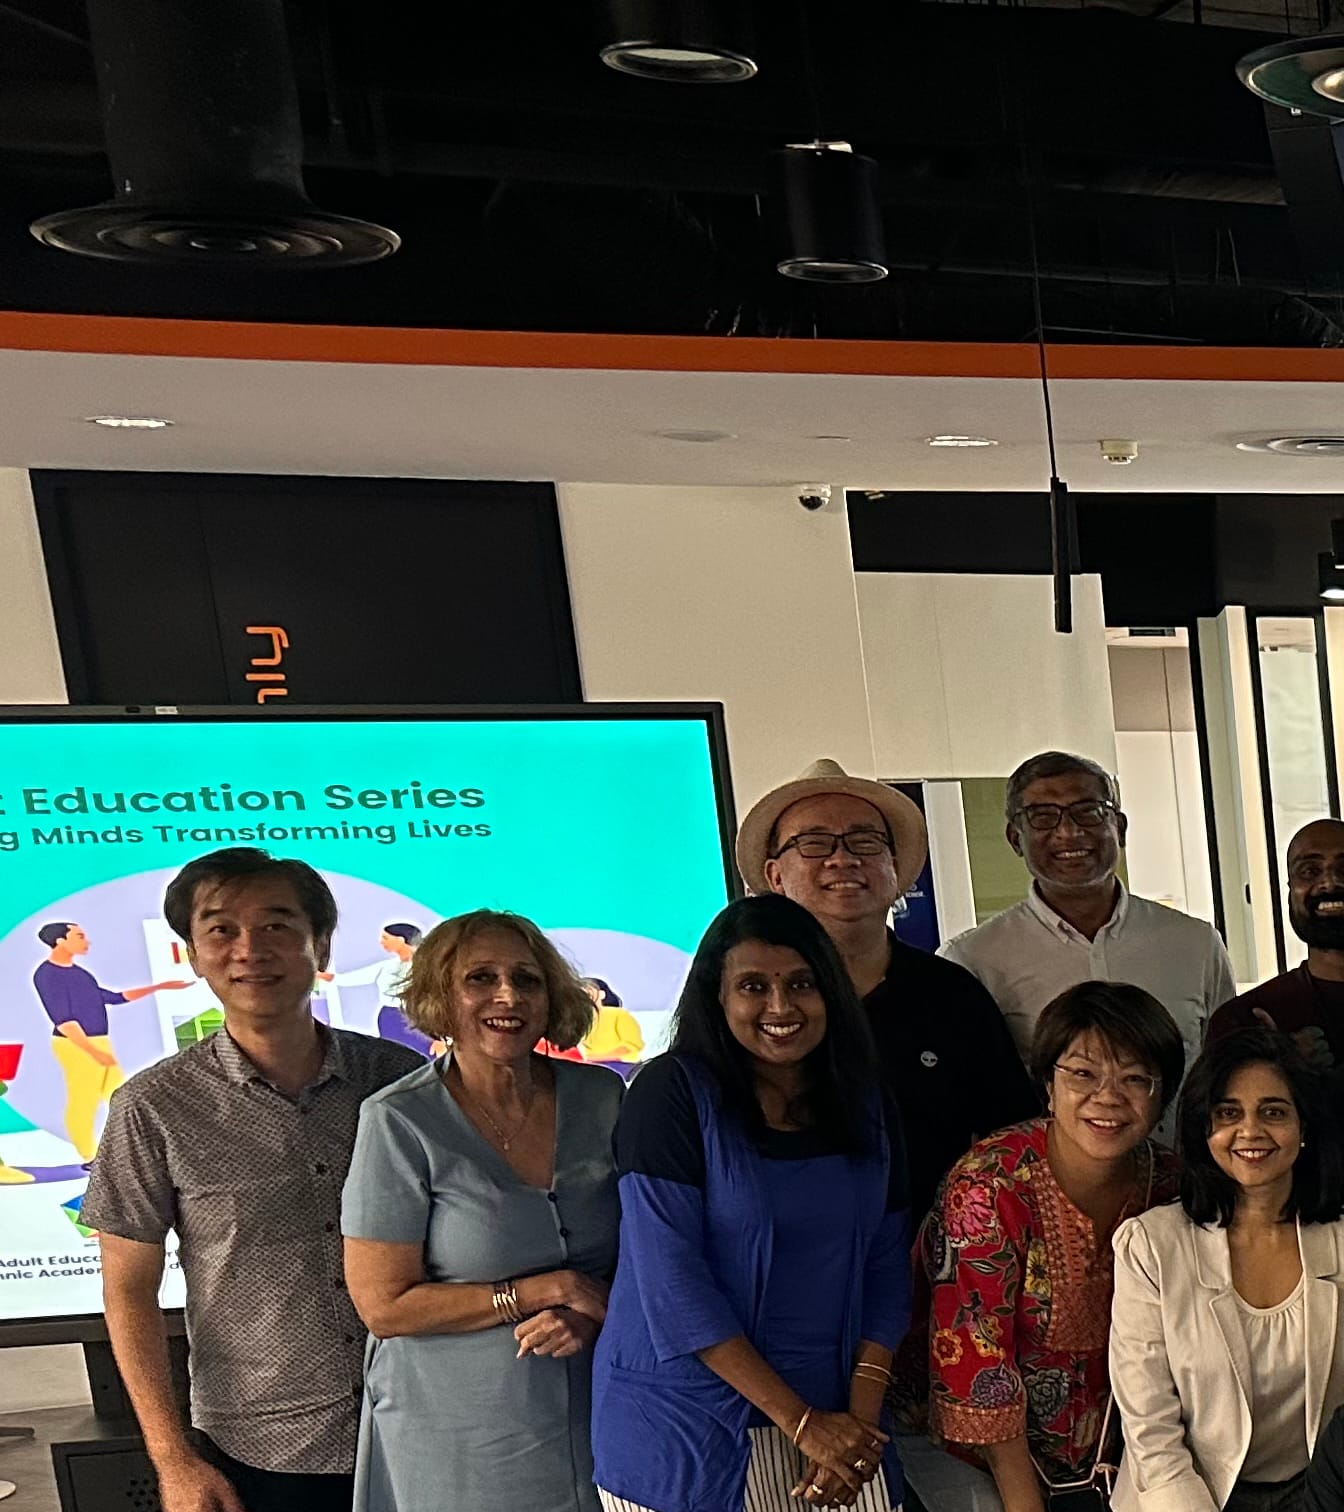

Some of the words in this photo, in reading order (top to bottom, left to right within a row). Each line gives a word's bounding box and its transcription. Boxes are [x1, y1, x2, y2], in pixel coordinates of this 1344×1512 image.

[22, 783, 306, 815] Education
[324, 780, 486, 810] Series
[31, 825, 144, 845] Minds
[152, 820, 397, 845] Transforming
[408, 819, 492, 838] Lives
